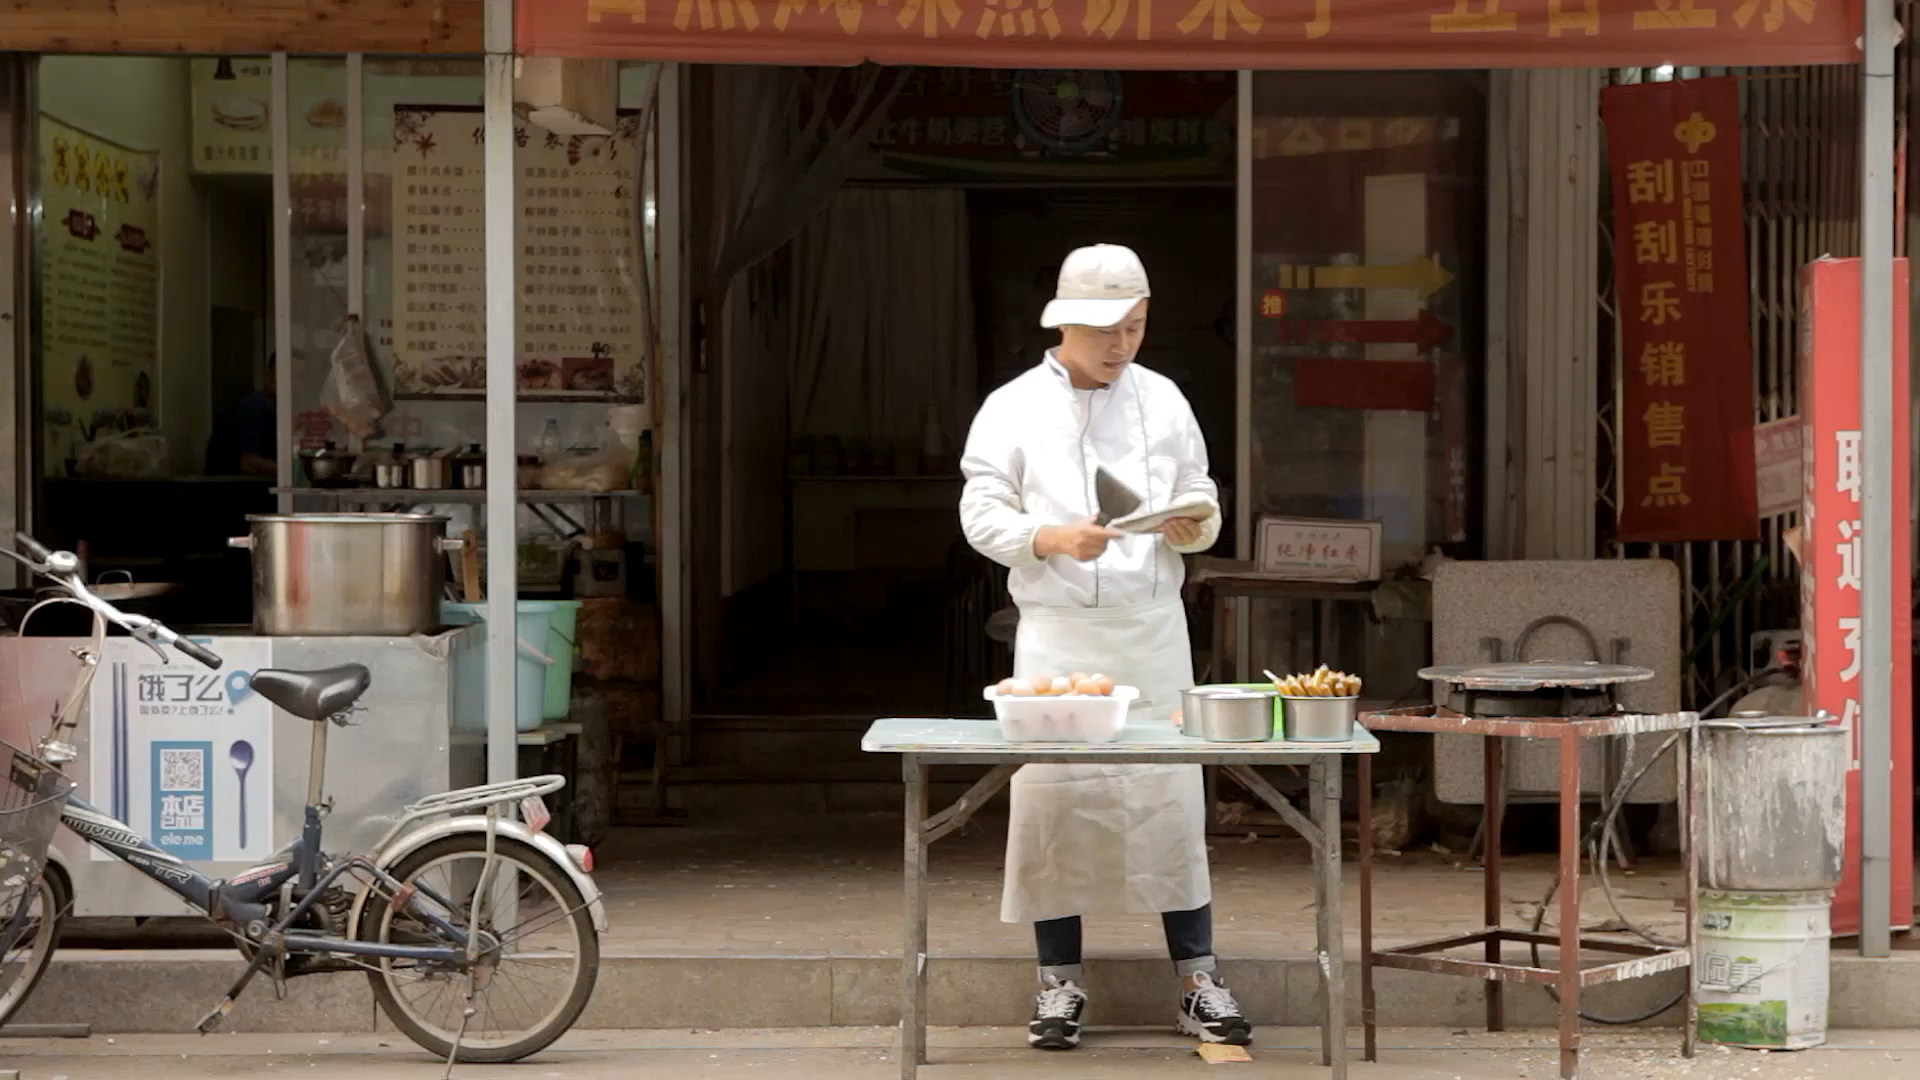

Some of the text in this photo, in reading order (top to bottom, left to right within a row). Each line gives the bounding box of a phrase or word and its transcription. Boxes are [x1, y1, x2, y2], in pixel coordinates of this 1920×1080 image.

[1262, 294, 1284, 315] 推
[1627, 159, 1691, 507] 刮刮乐销售点
[138, 675, 223, 702] 饿了么
[161, 795, 204, 816] 本店
[160, 832, 205, 845] ele.me
